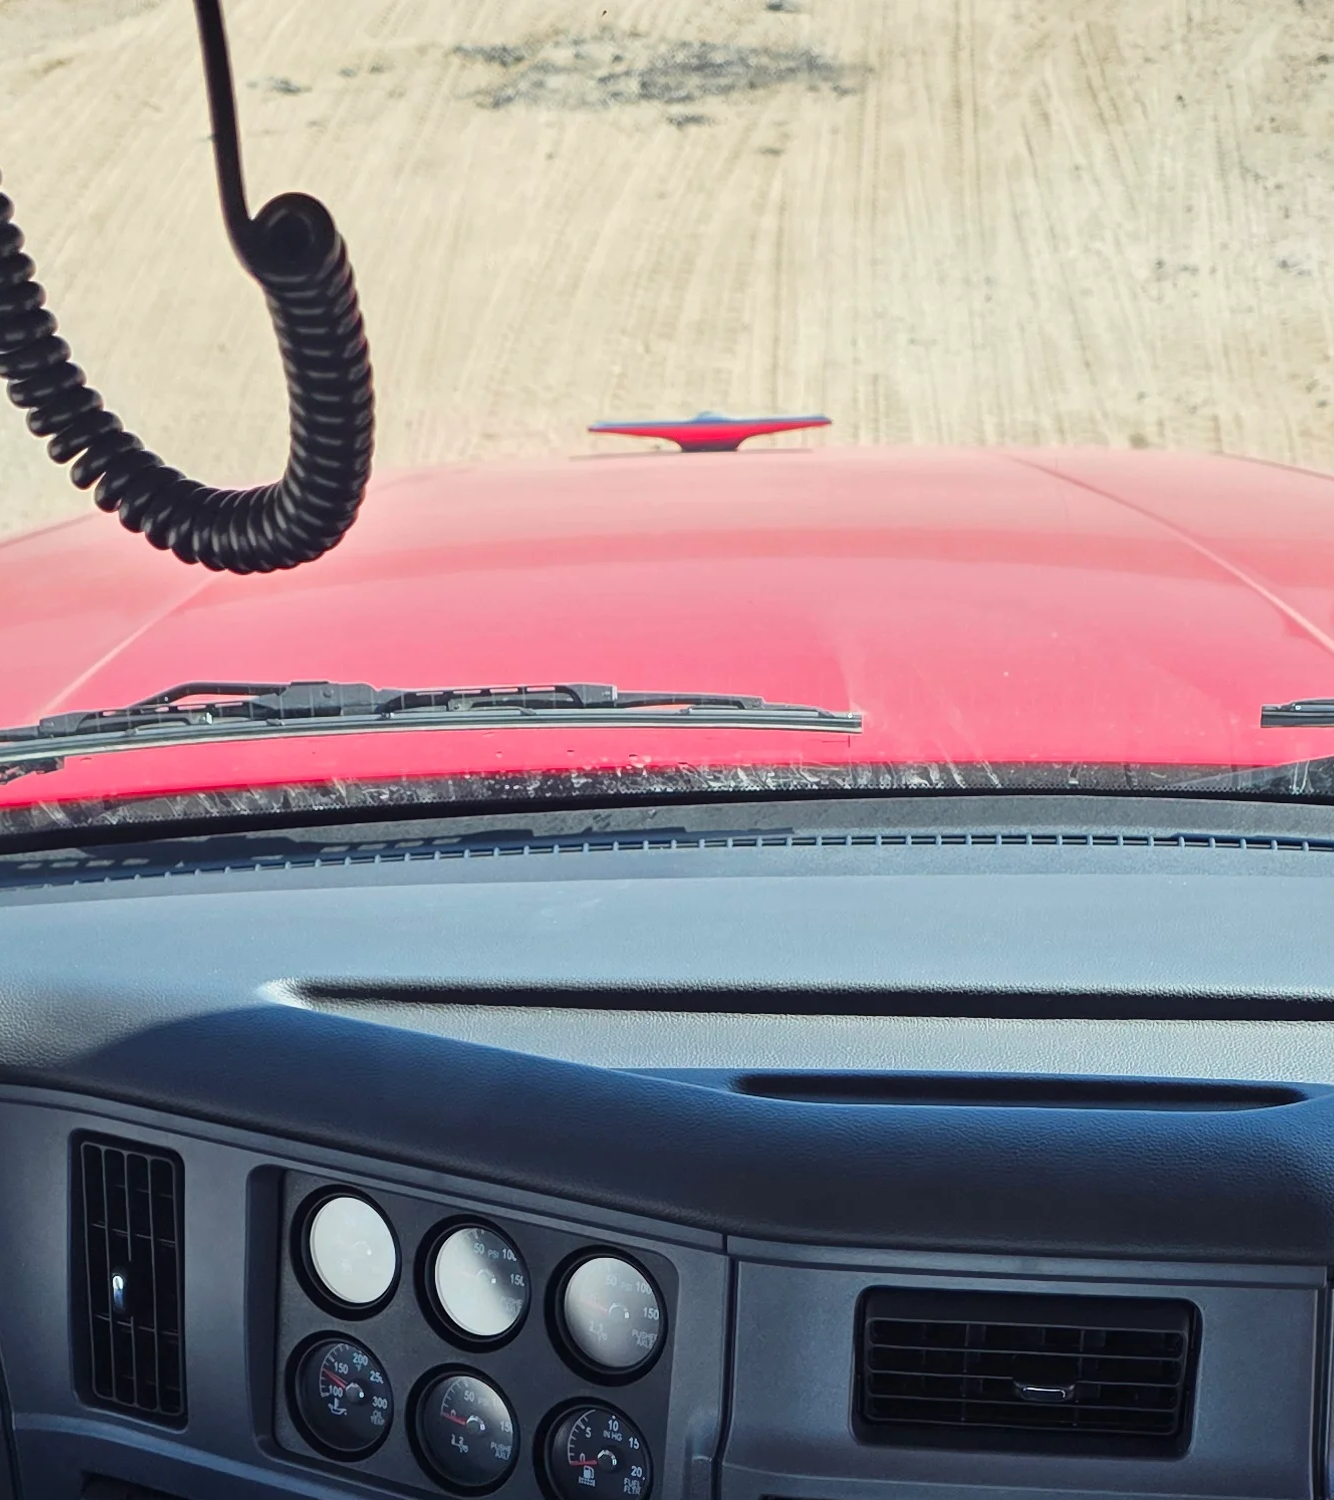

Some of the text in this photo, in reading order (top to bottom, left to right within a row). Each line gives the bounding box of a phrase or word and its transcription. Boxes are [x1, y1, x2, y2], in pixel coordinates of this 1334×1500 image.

[334, 1361, 349, 1375] 150
[328, 1384, 344, 1398] 100
[464, 1390, 475, 1403] 50
[608, 1419, 619, 1432] 10
[585, 1426, 592, 1439] 5
[628, 1436, 640, 1450] 15
[631, 1465, 643, 1478] 20
